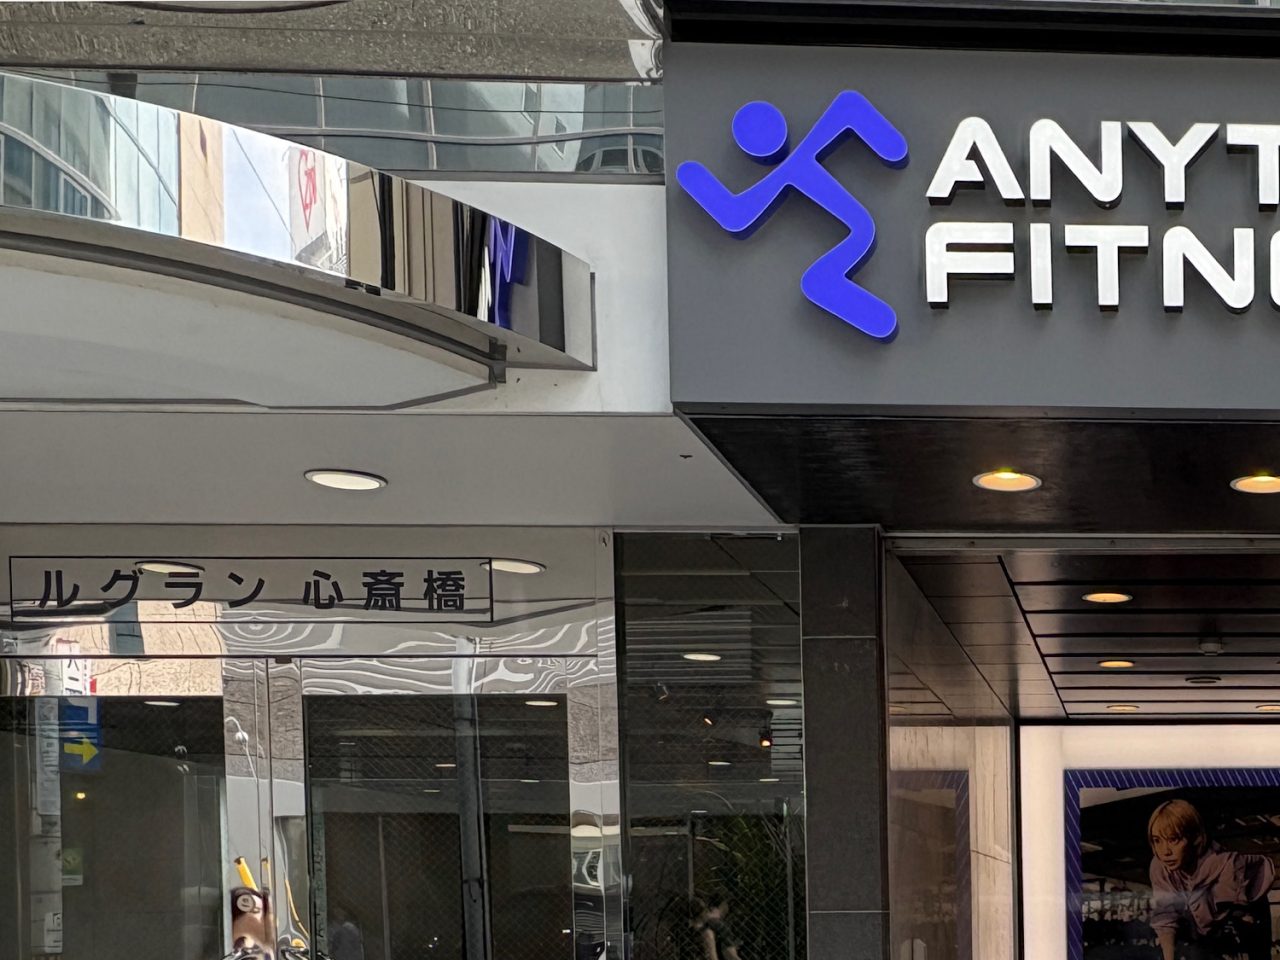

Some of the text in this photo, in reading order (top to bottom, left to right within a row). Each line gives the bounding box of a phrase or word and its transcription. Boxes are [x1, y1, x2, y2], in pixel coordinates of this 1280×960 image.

[38, 569, 466, 612] ルグラン 心斎橋
